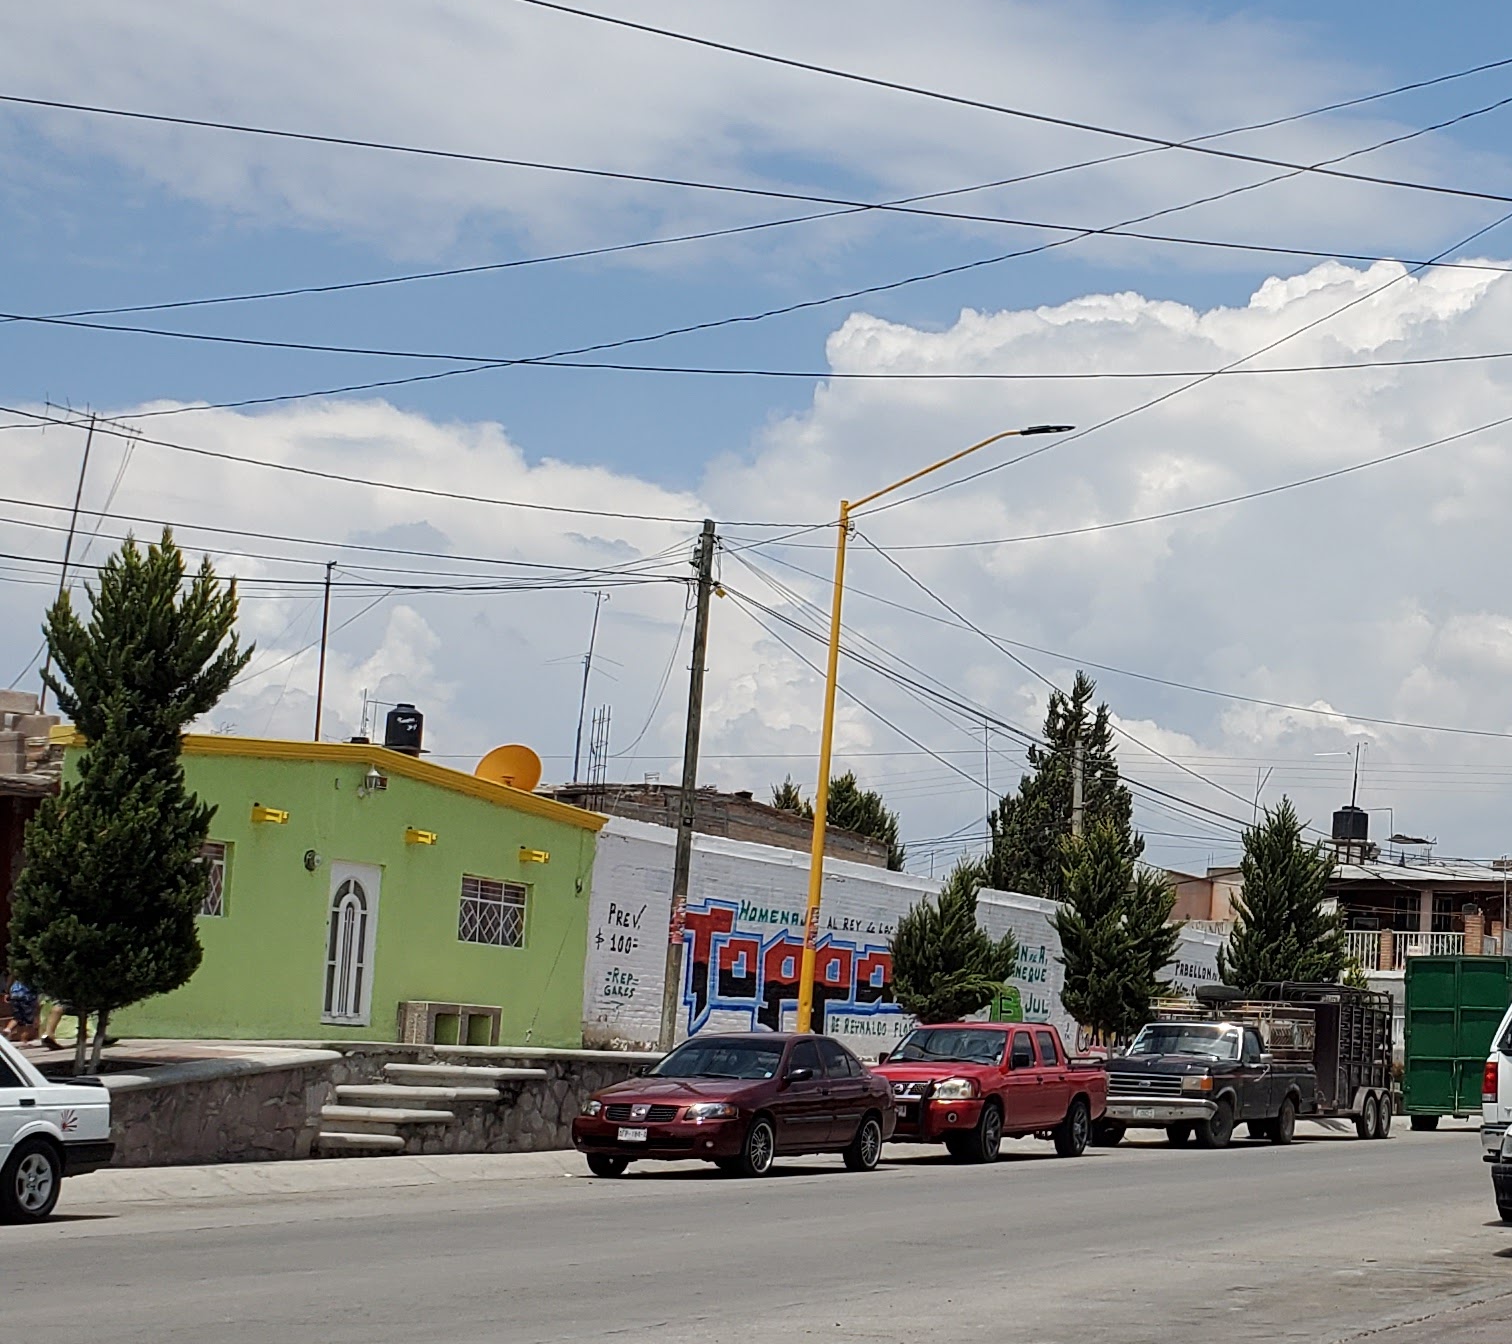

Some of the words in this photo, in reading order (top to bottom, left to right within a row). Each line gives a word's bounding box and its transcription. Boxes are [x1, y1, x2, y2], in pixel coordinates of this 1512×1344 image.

[741, 899, 808, 926] HOMENAJ
[827, 916, 838, 929] AL
[843, 917, 861, 932] REY
[1025, 993, 1048, 1014] JUL
